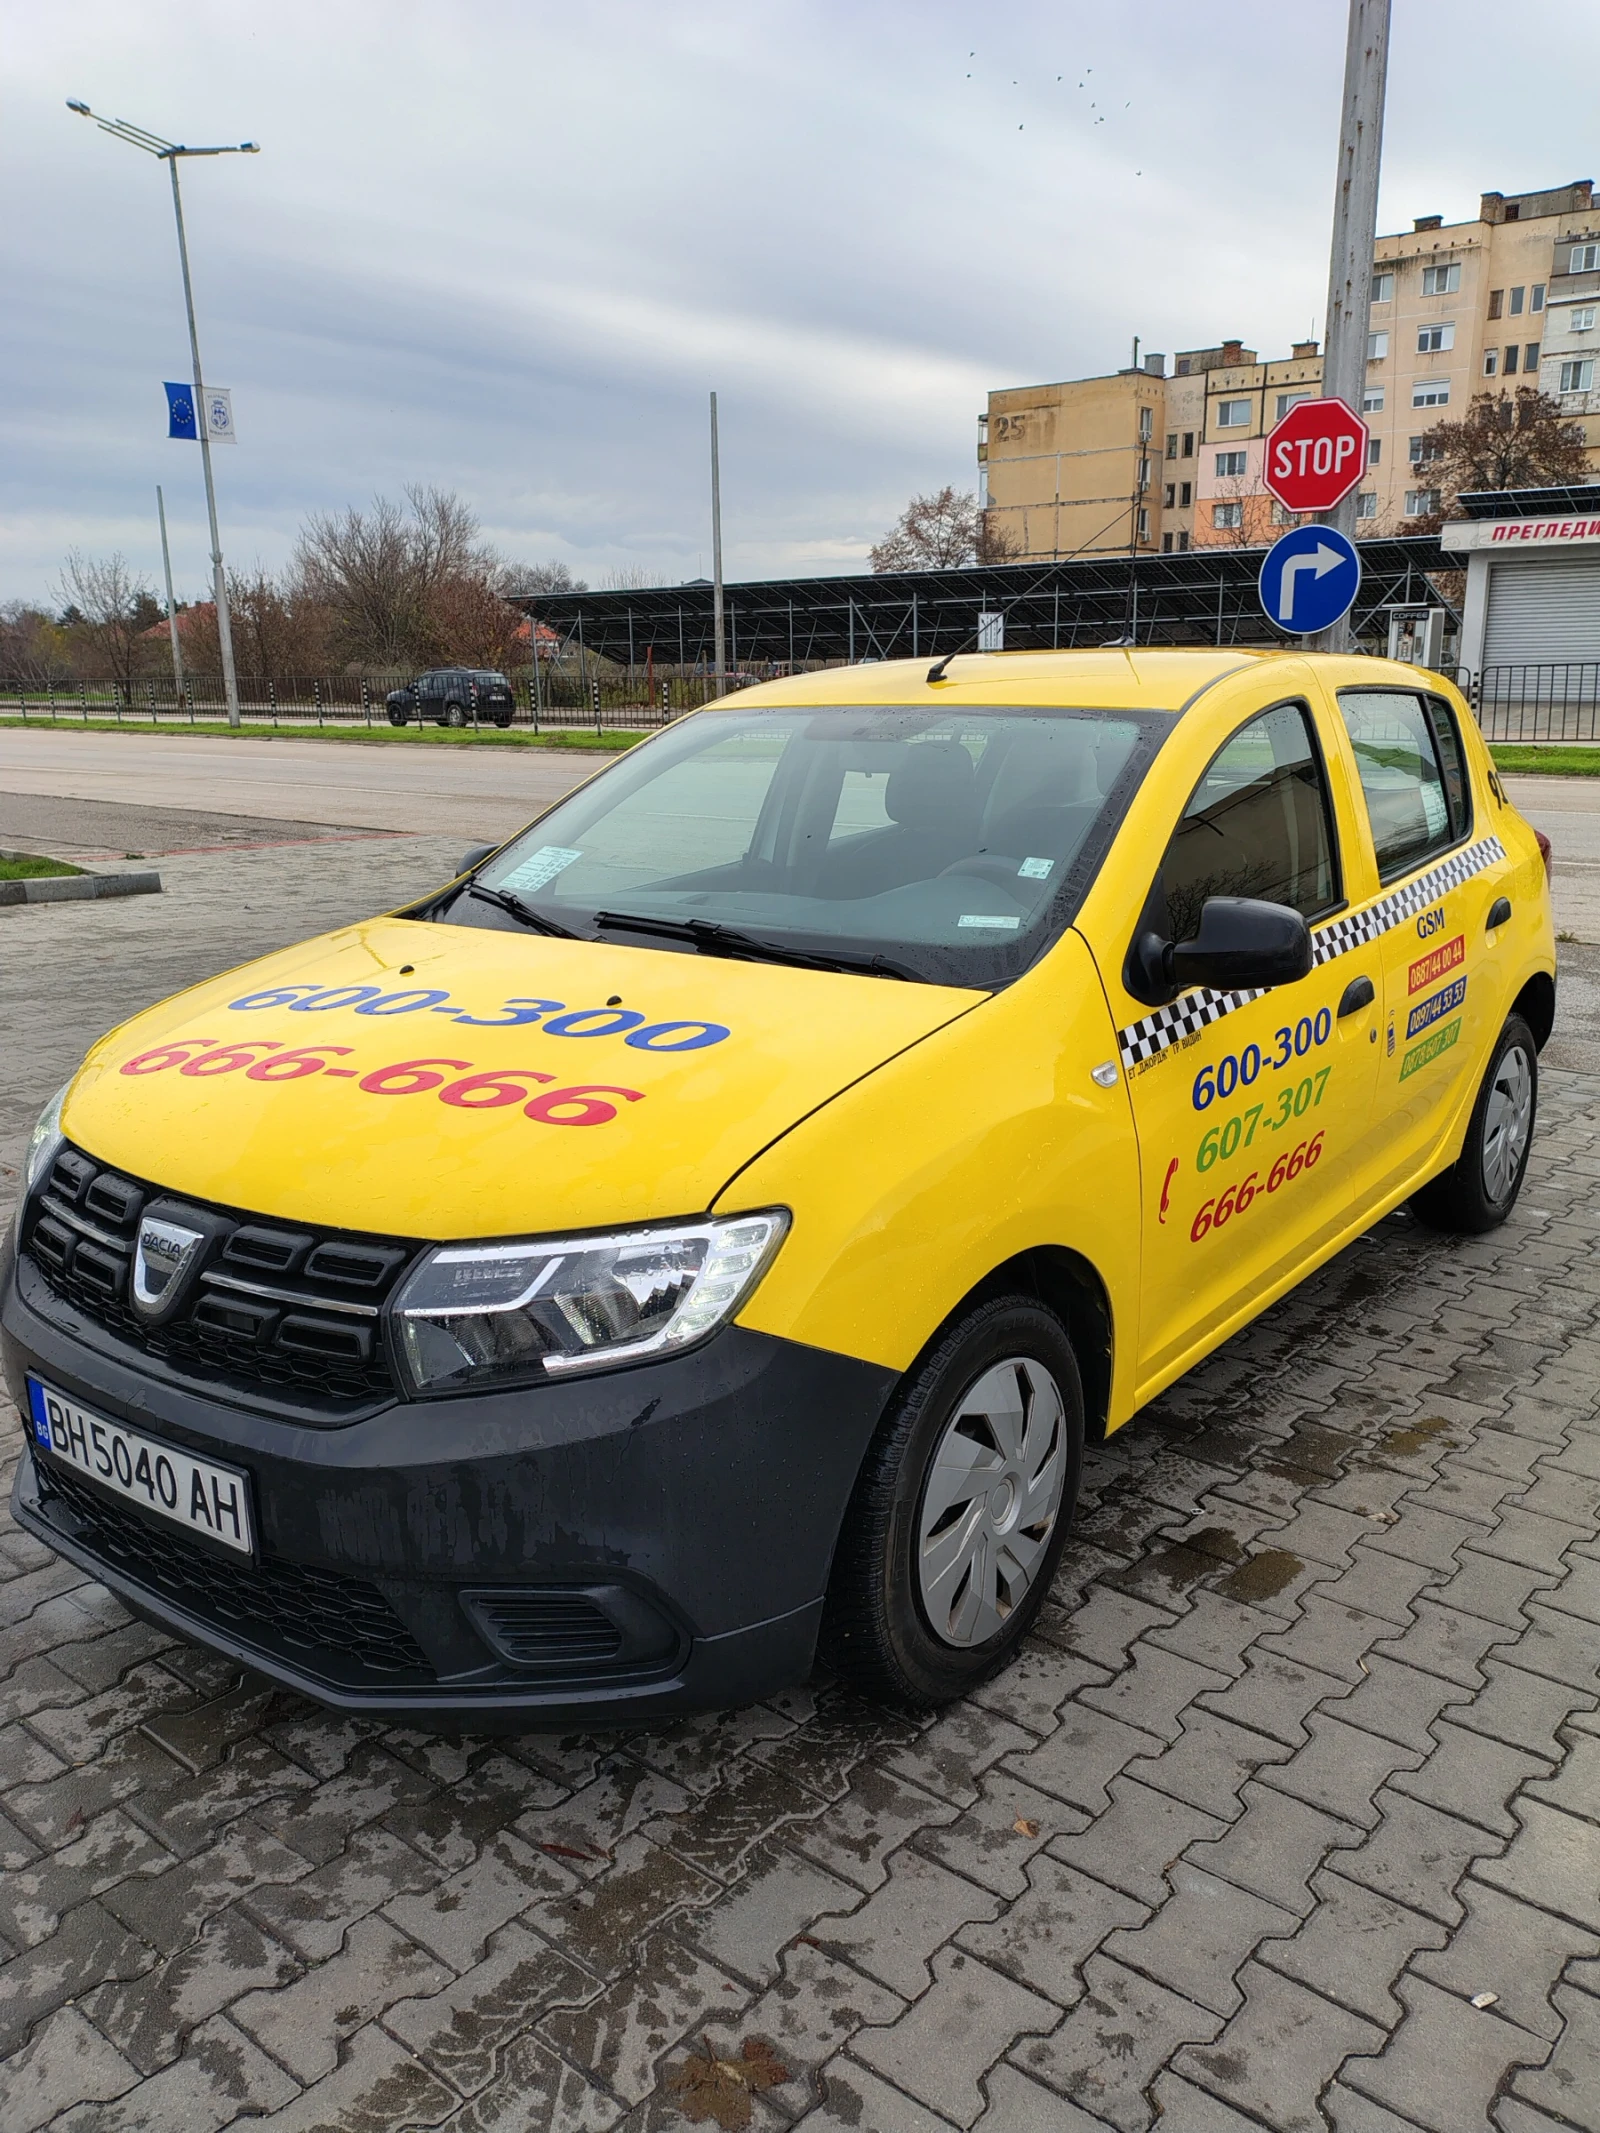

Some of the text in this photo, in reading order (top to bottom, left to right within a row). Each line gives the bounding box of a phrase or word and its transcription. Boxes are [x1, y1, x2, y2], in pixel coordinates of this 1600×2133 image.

[993, 414, 1026, 443] 25
[1274, 435, 1356, 479] STOP
[1392, 611, 1429, 620] COFFEE
[1416, 907, 1445, 939] GSM
[1442, 947, 1452, 968] 00
[1452, 940, 1462, 961] 44
[1442, 988, 1453, 1010] 53
[1453, 981, 1464, 1003] 53
[227, 985, 731, 1052] 600-300
[1182, 1031, 1202, 1049] ВИДИН
[1192, 1007, 1331, 1111] 600-300
[119, 1039, 646, 1126] 666-666
[1196, 1065, 1332, 1173] 607-307
[1190, 1130, 1325, 1243] 666-666
[142, 1233, 180, 1256] DACIA
[36, 1420, 48, 1440] BG
[190, 1468, 242, 1541] AH
